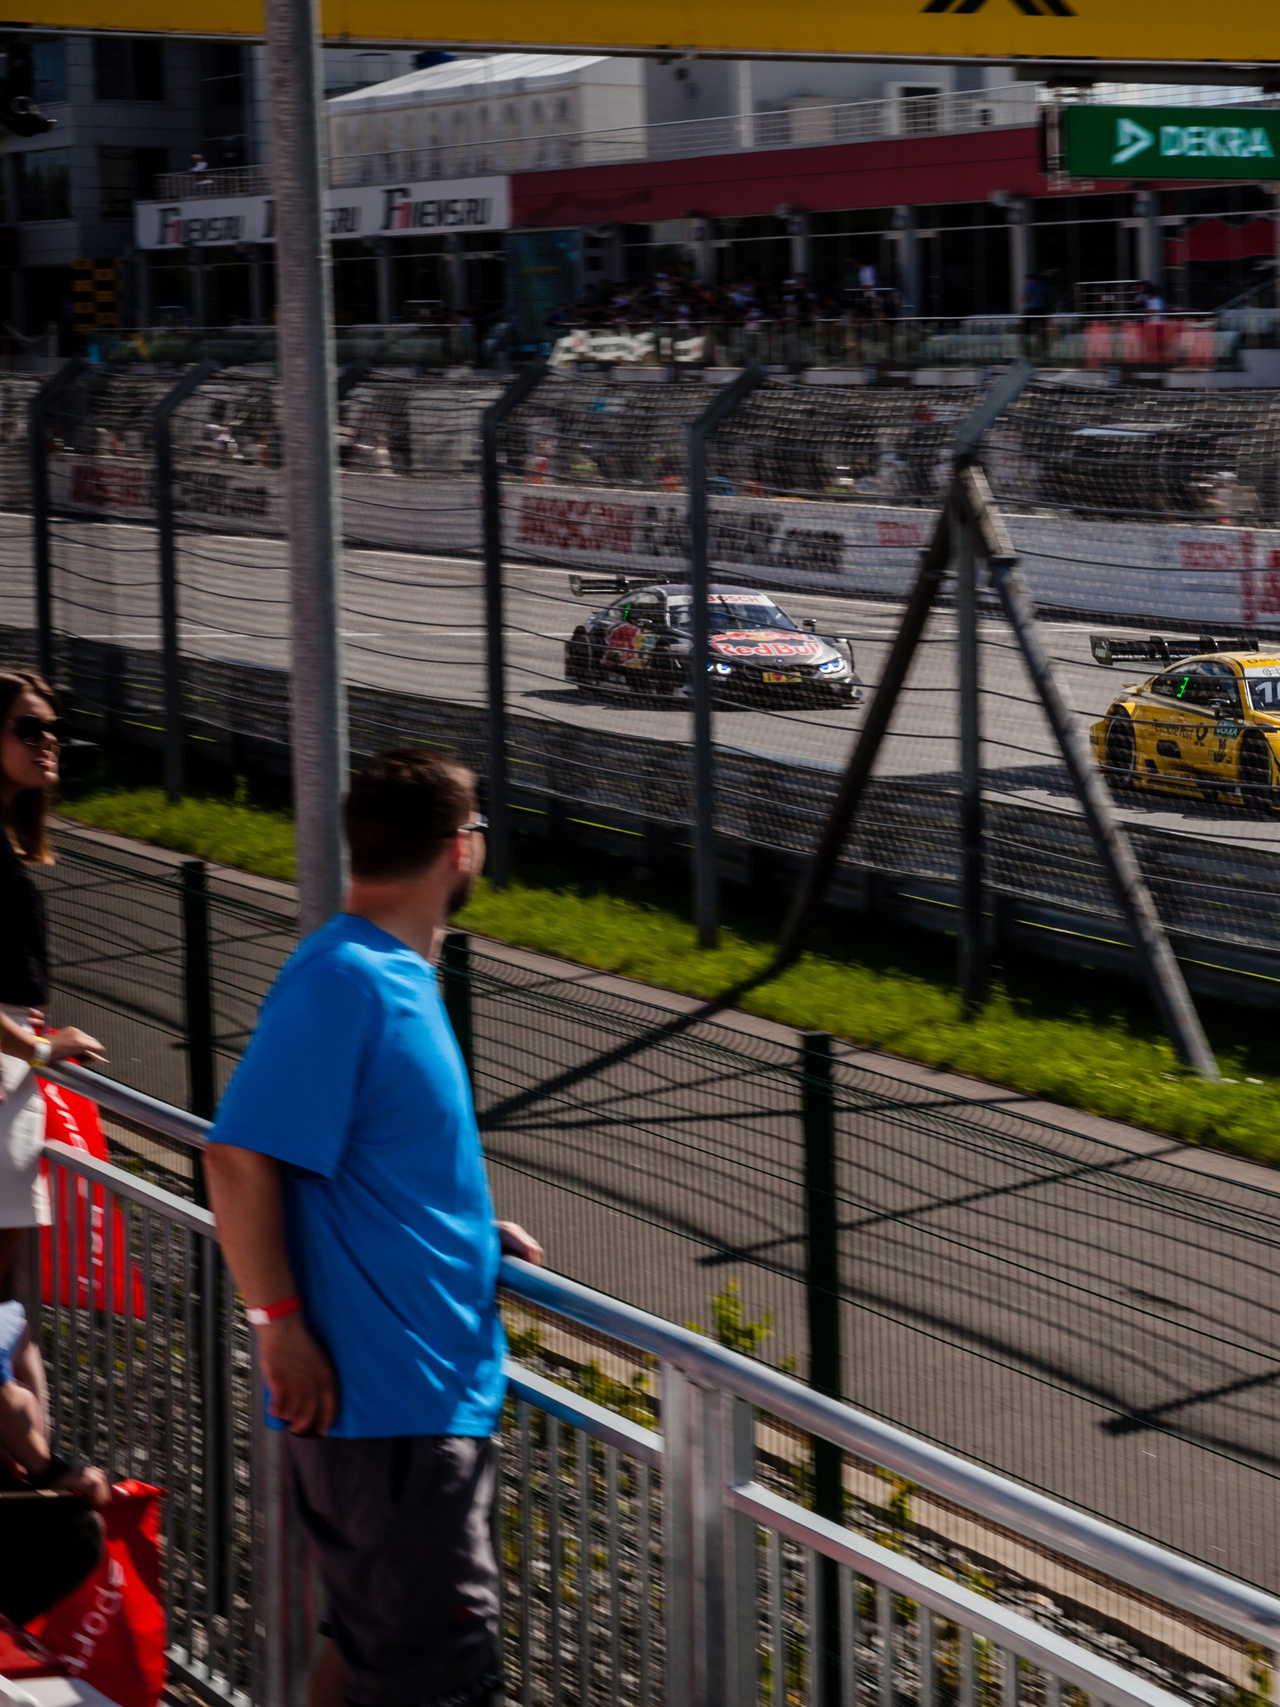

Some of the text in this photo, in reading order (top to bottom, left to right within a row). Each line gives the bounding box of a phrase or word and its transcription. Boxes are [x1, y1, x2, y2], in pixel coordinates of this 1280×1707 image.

[1159, 125, 1275, 158] DEKRA
[710, 641, 821, 656] Red Bull
